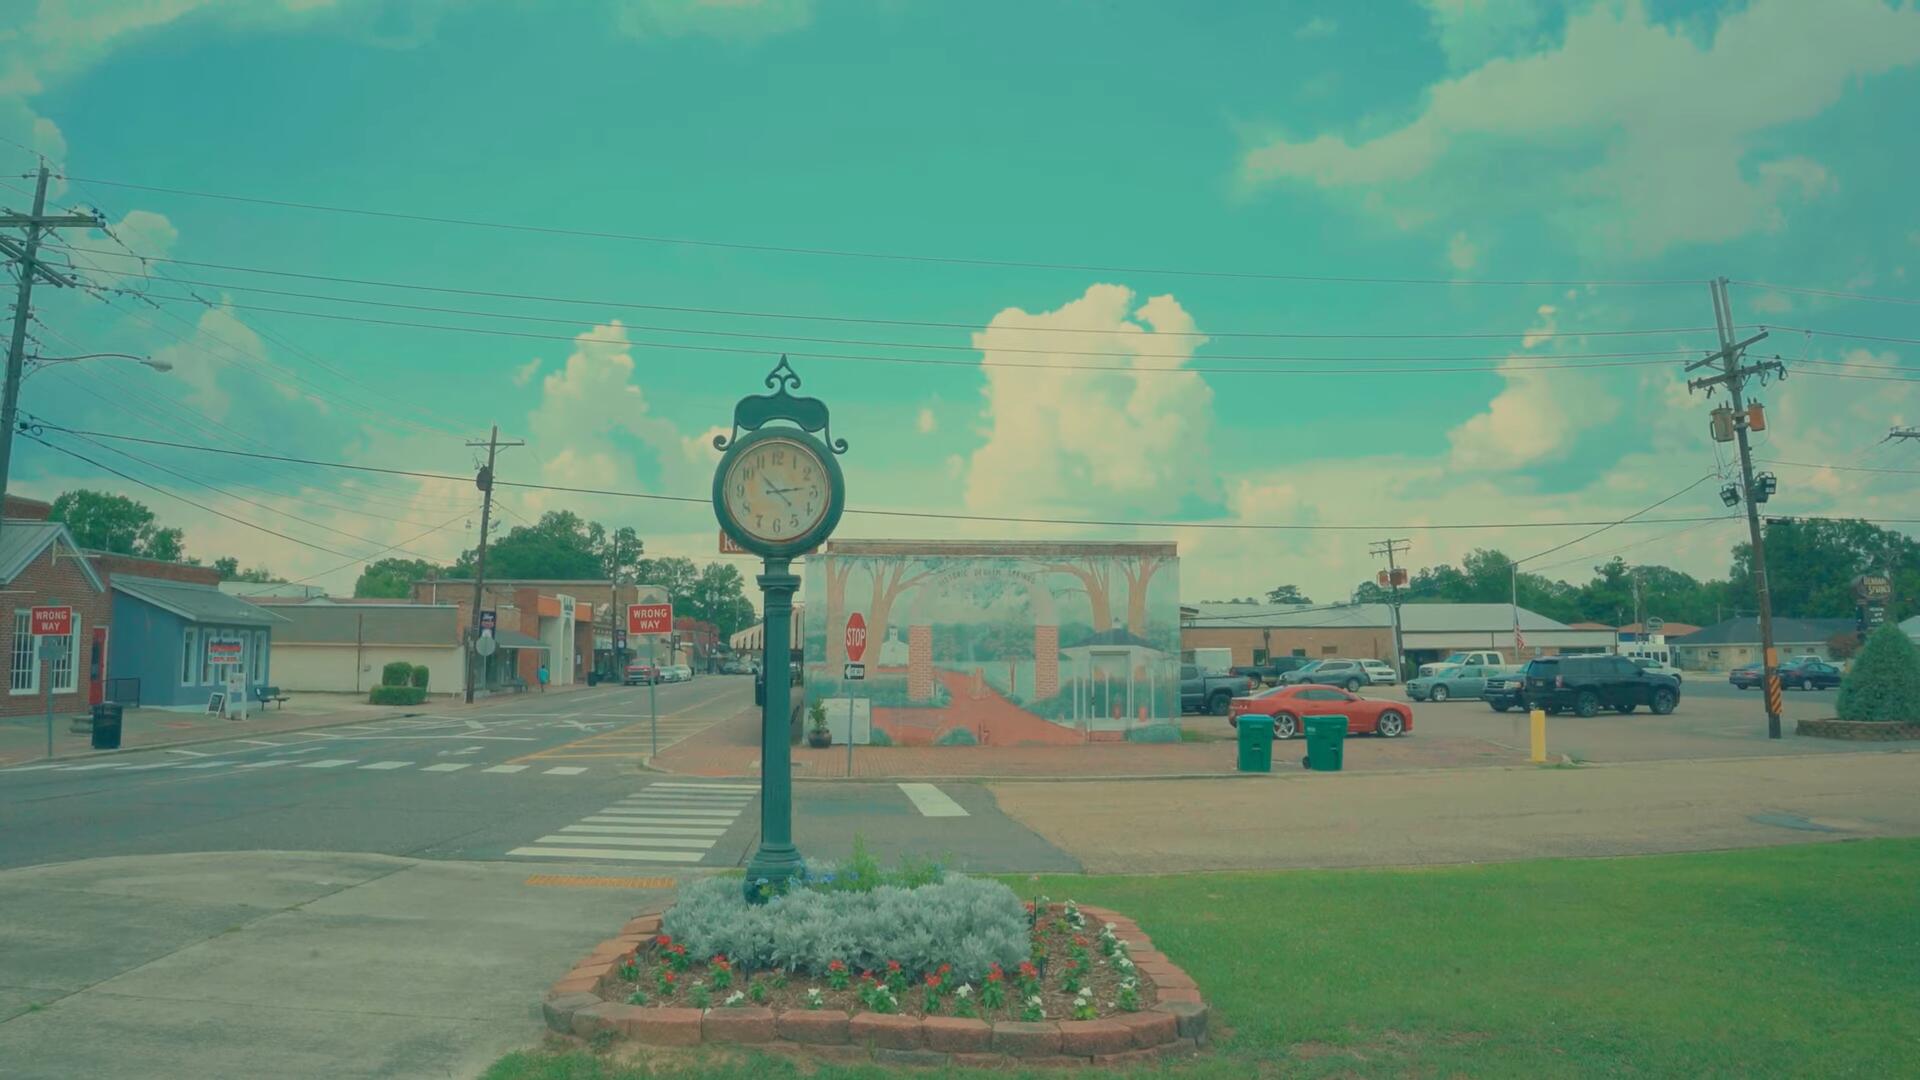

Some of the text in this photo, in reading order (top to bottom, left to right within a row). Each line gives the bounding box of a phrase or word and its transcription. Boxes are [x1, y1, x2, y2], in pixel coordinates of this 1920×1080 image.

[757, 455, 765, 469] 11
[772, 451, 784, 466] 12
[743, 466, 754, 482] 10
[803, 466, 811, 482] 2
[736, 484, 744, 498] 9
[809, 485, 818, 499] 3
[742, 501, 751, 517] 8
[806, 502, 814, 516] 4
[755, 515, 764, 529] 7
[773, 518, 781, 533] 6
[789, 514, 799, 528] 5
[35, 610, 67, 620] WRONG
[633, 608, 668, 618] WRONG
[41, 622, 61, 631] WAY
[640, 620, 661, 629] WAY
[846, 627, 866, 646] STOP
